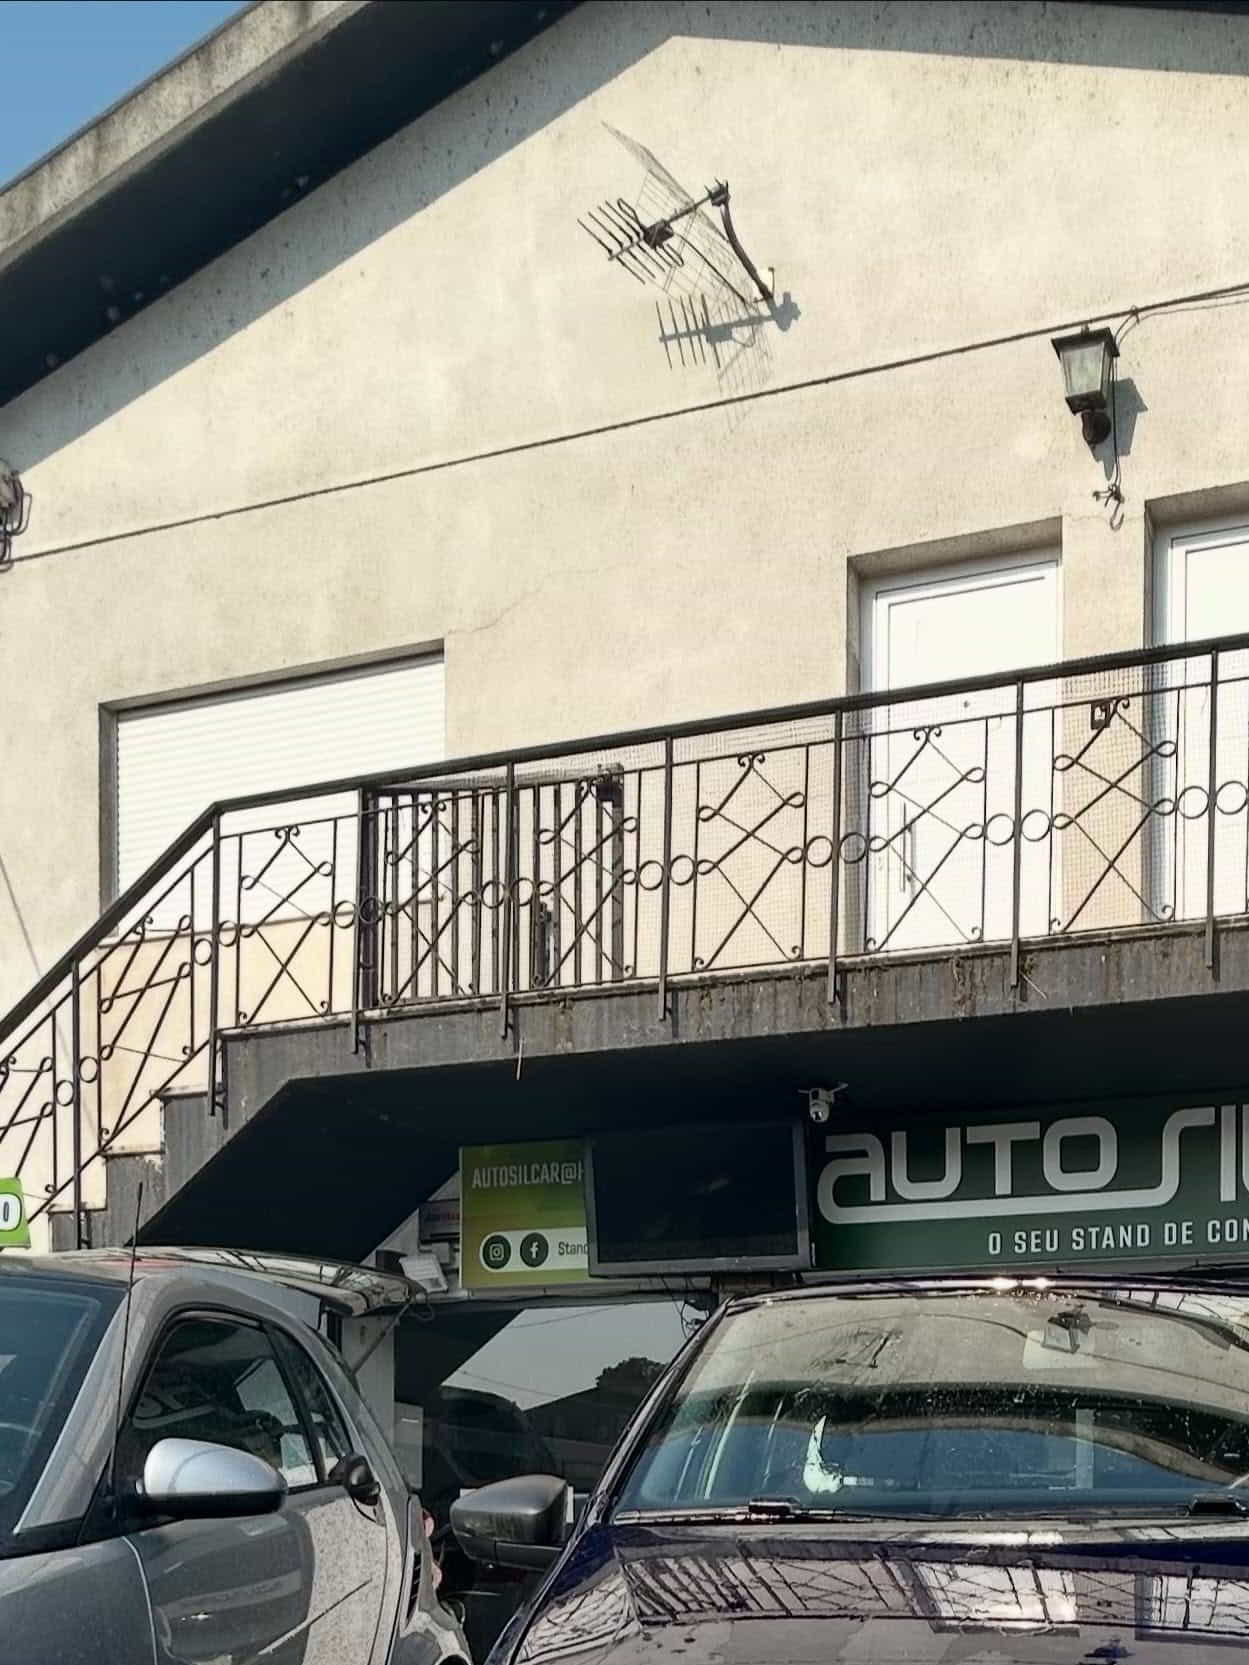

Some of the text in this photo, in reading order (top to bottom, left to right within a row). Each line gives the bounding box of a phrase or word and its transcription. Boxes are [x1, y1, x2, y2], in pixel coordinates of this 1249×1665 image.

[988, 1232, 1001, 1255] O
[1014, 1229, 1059, 1254] SEU
[1071, 1223, 1150, 1251] STAND
[1164, 1221, 1193, 1246] DE
